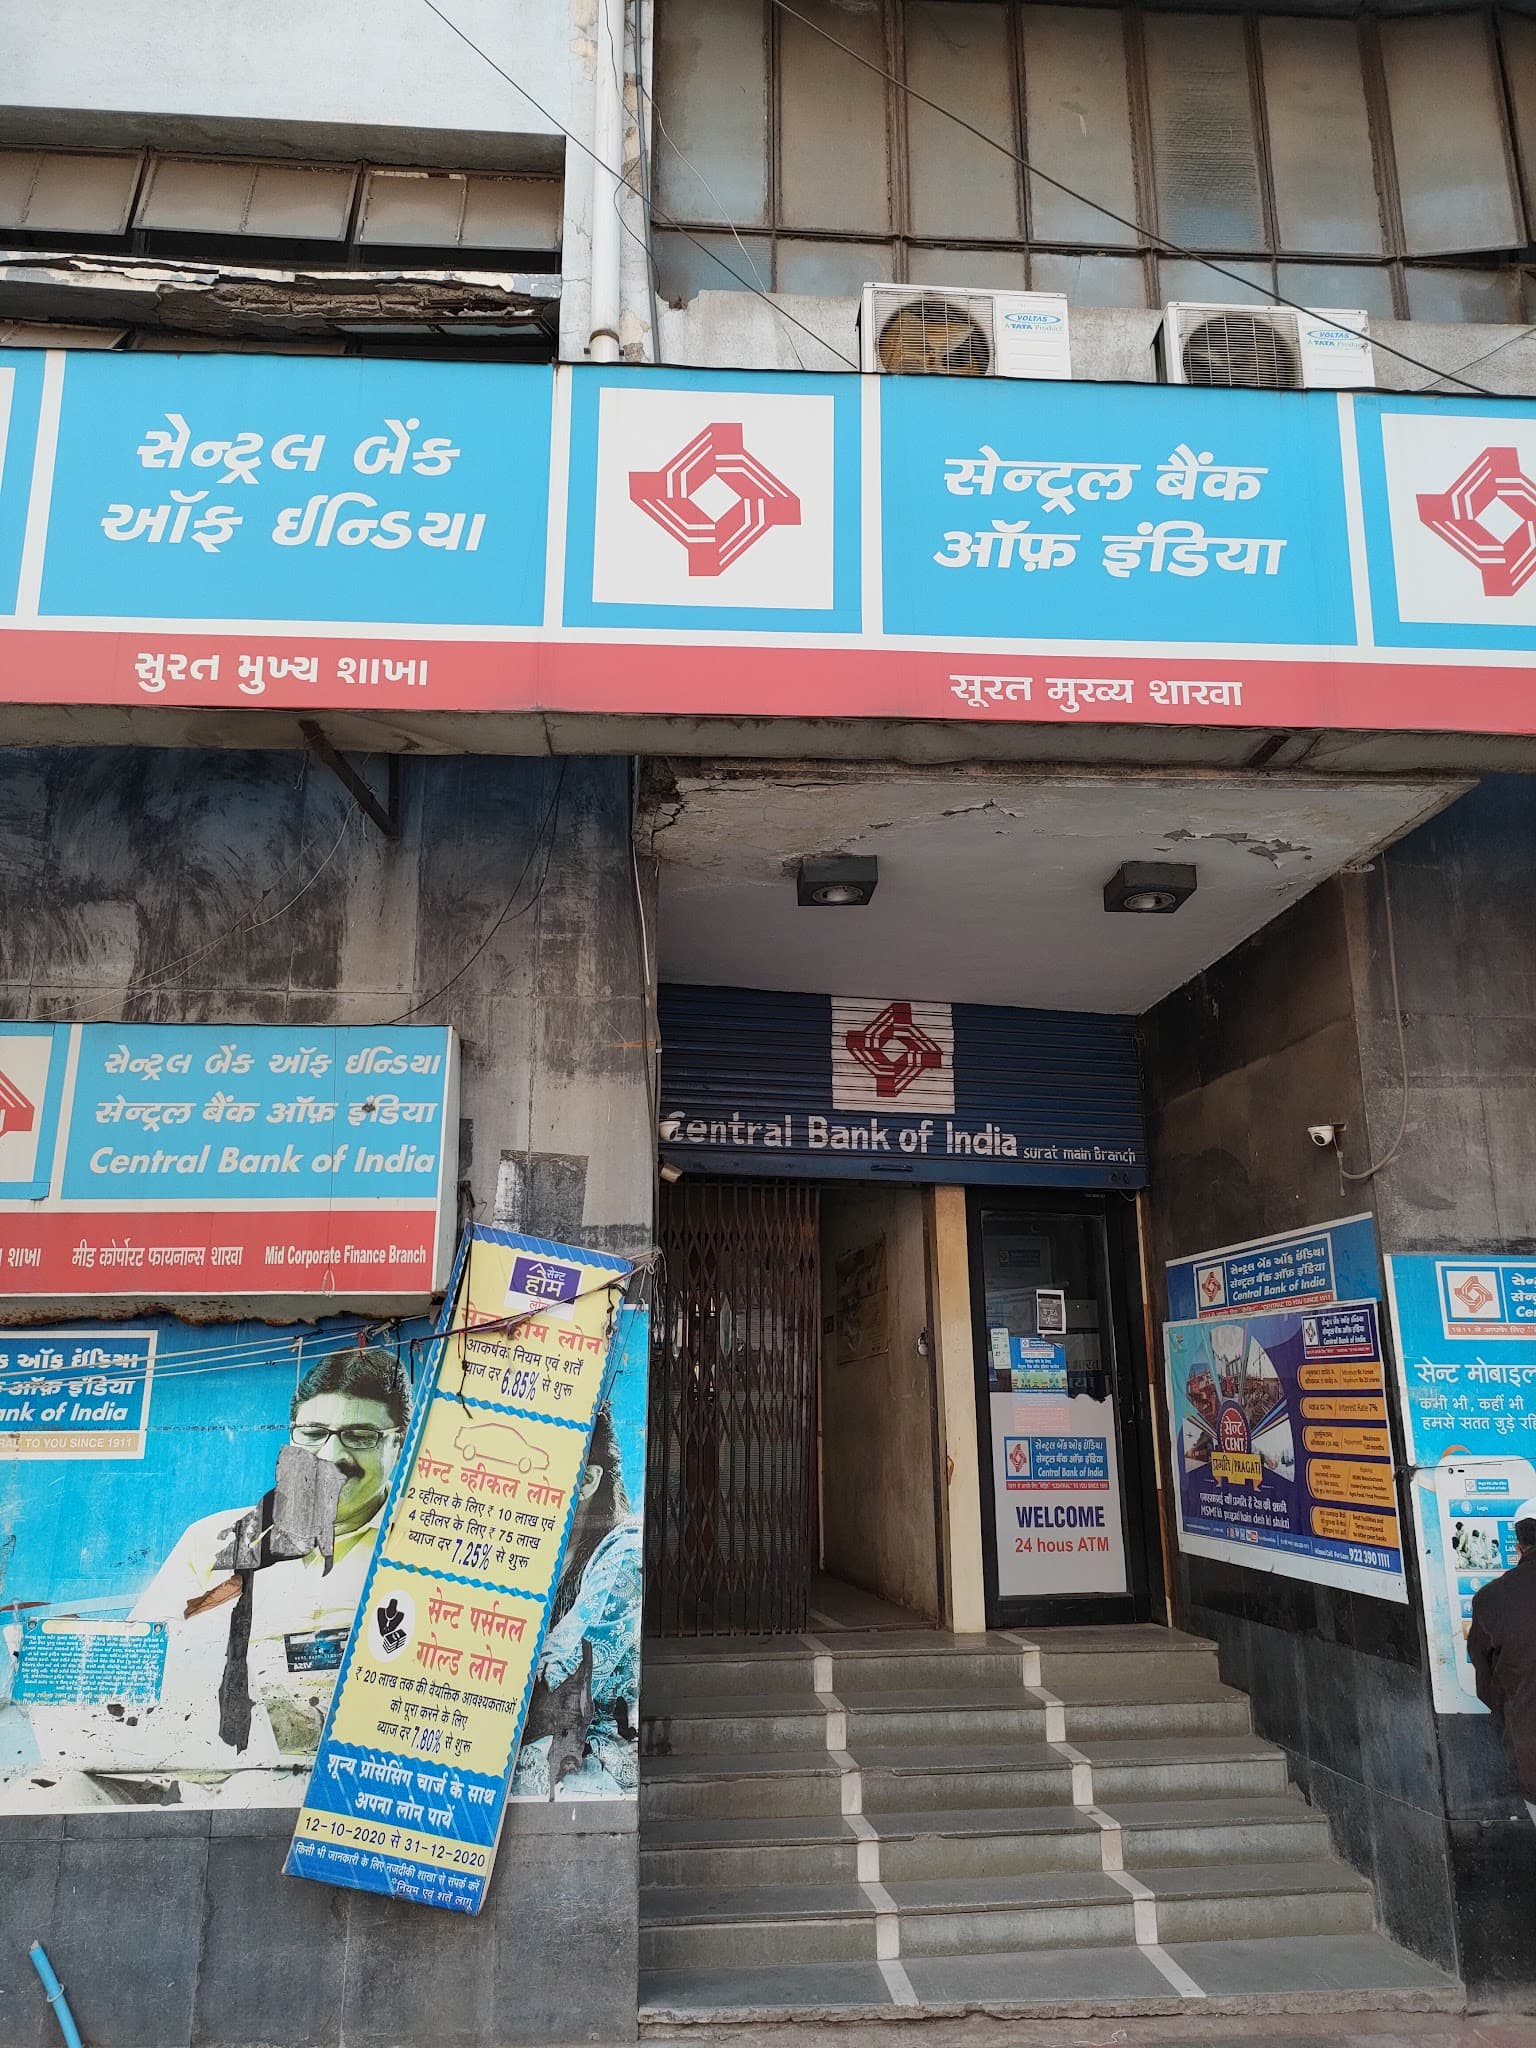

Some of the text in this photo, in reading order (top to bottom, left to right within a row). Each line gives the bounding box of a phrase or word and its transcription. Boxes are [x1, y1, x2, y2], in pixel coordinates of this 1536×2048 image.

[1017, 314, 1048, 322] VOLTAS
[1319, 331, 1350, 339] VOLTAS
[137, 413, 462, 485] સેન્ટ્રલ બેંક
[944, 444, 1269, 515] सेन्ट्रल बैंक
[933, 520, 1288, 578] ऑफ़ इंडिया
[134, 651, 429, 696] સુરત મુખ્ય શાખા
[950, 674, 1243, 713] सूरत मुख्य शाखा
[104, 1045, 193, 1081] સેન્ટ્રલ
[204, 1045, 256, 1075] બેંક
[95, 1091, 438, 1132] सेन्ट्रल बैंक ऑफ़ इंडिया
[808, 1115, 891, 1150] Bank
[899, 1119, 934, 1154] of
[946, 1121, 1019, 1157] India
[1063, 1147, 1092, 1162] main
[89, 1144, 436, 1175] Central Bank of India
[7, 1247, 42, 1267] શાખા
[72, 1238, 97, 1268] मीड
[210, 1246, 245, 1267] शाखा
[265, 1245, 427, 1268] Mid Corporate Finance Branch
[525, 1267, 565, 1298] होम
[1232, 1276, 1326, 1301] Central Bank of India
[558, 1325, 604, 1355] लोन
[513, 1346, 541, 1368] नियम
[545, 1354, 562, 1372] एवं
[1414, 1356, 1461, 1383] सेन्ट
[488, 1366, 574, 1401] दर 6.85% से शुरू
[40, 1401, 129, 1421] of India
[1420, 1393, 1524, 1412] कभी कहीं भी
[1223, 1415, 1243, 1435] सेन्ट
[1421, 1413, 1516, 1435] हमसे सतत जुड़े
[25, 1438, 41, 1447] TO
[44, 1438, 67, 1447] YOU
[70, 1437, 105, 1447] SINCE
[108, 1438, 131, 1447] 1911
[1224, 1437, 1245, 1452] CENT
[417, 1449, 567, 1510] सेन्ट व्हीकल लोन
[1037, 1466, 1104, 1477] Central Bank of India
[407, 1487, 557, 1532] 2 व्हीलर के लिए 10 लाख एवं
[1015, 1505, 1106, 1528] WELCOME
[408, 1509, 542, 1550] 4 व्हीलर के लिए 75 लाख
[1015, 1536, 1110, 1553] 24 hous ATM
[408, 1530, 531, 1571] ब्याज दर 7.25% से शुरू
[1349, 1547, 1363, 1564] 922
[1363, 1549, 1378, 1566] 390
[1378, 1552, 1391, 1569] 1111
[428, 1586, 528, 1643] सेन्ट पर्सनल
[416, 1631, 509, 1686] गोल्ड लोन
[363, 1669, 377, 1684] 20
[378, 1672, 399, 1690] लाख
[399, 1677, 415, 1693] तक
[415, 1677, 428, 1696] की
[404, 1702, 469, 1732] पूरा करने के लिए
[376, 1720, 473, 1757] ब्याज दर 7.80% से शुरू
[327, 1752, 358, 1781] शून्य
[416, 1768, 448, 1796] चार्ज
[449, 1774, 465, 1800] के
[467, 1785, 497, 1807] साथ
[355, 1790, 394, 1816] अपना
[396, 1792, 424, 1823] लोन
[304, 1816, 486, 1868] 12-10-2020 से 31-12-2020
[295, 1840, 315, 1857] किसी
[316, 1845, 327, 1859] भी
[328, 1848, 360, 1866] जानकारी
[360, 1852, 369, 1867] के
[370, 1855, 385, 1873] लिए
[417, 1866, 437, 1883] शाखा
[438, 1869, 447, 1885] से
[467, 1877, 481, 1892] करें
[421, 1886, 474, 1912] एवं लागू
